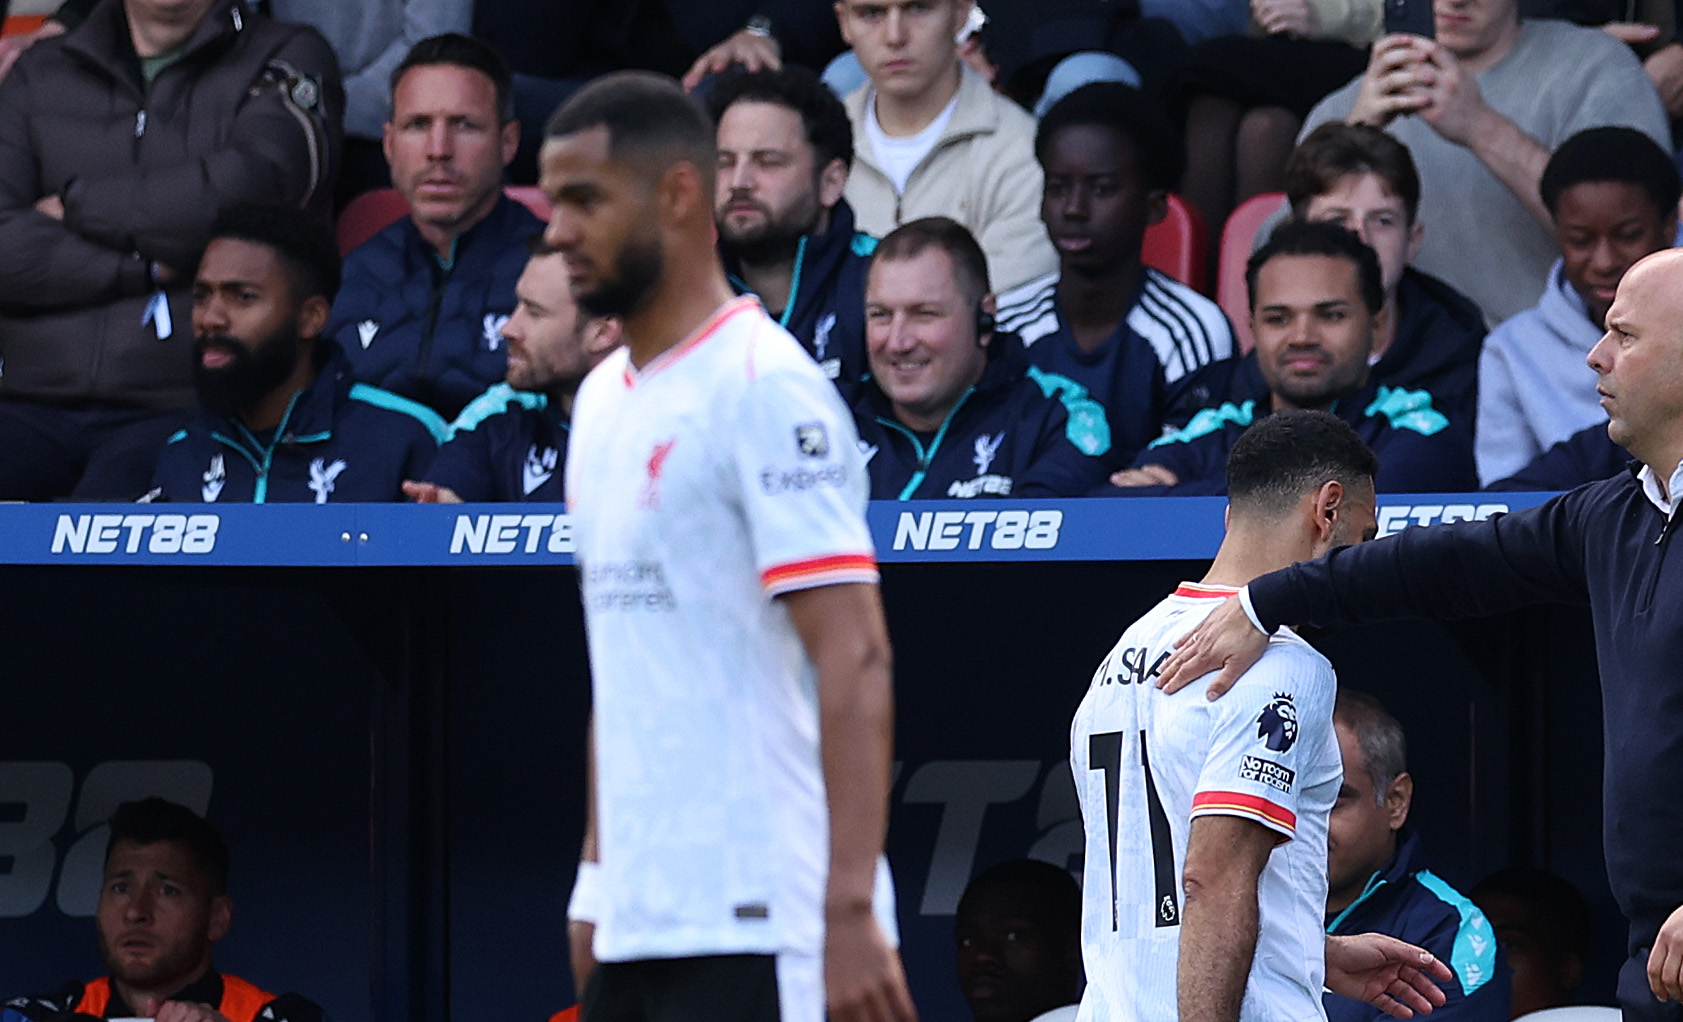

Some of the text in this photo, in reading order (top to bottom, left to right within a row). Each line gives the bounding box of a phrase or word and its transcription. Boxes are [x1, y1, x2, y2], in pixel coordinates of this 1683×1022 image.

[946, 474, 1013, 498] NET88
[51, 514, 219, 554] NET88
[893, 510, 1063, 550] NET88
[1241, 755, 1290, 782] No room
[1089, 729, 1180, 932] 11
